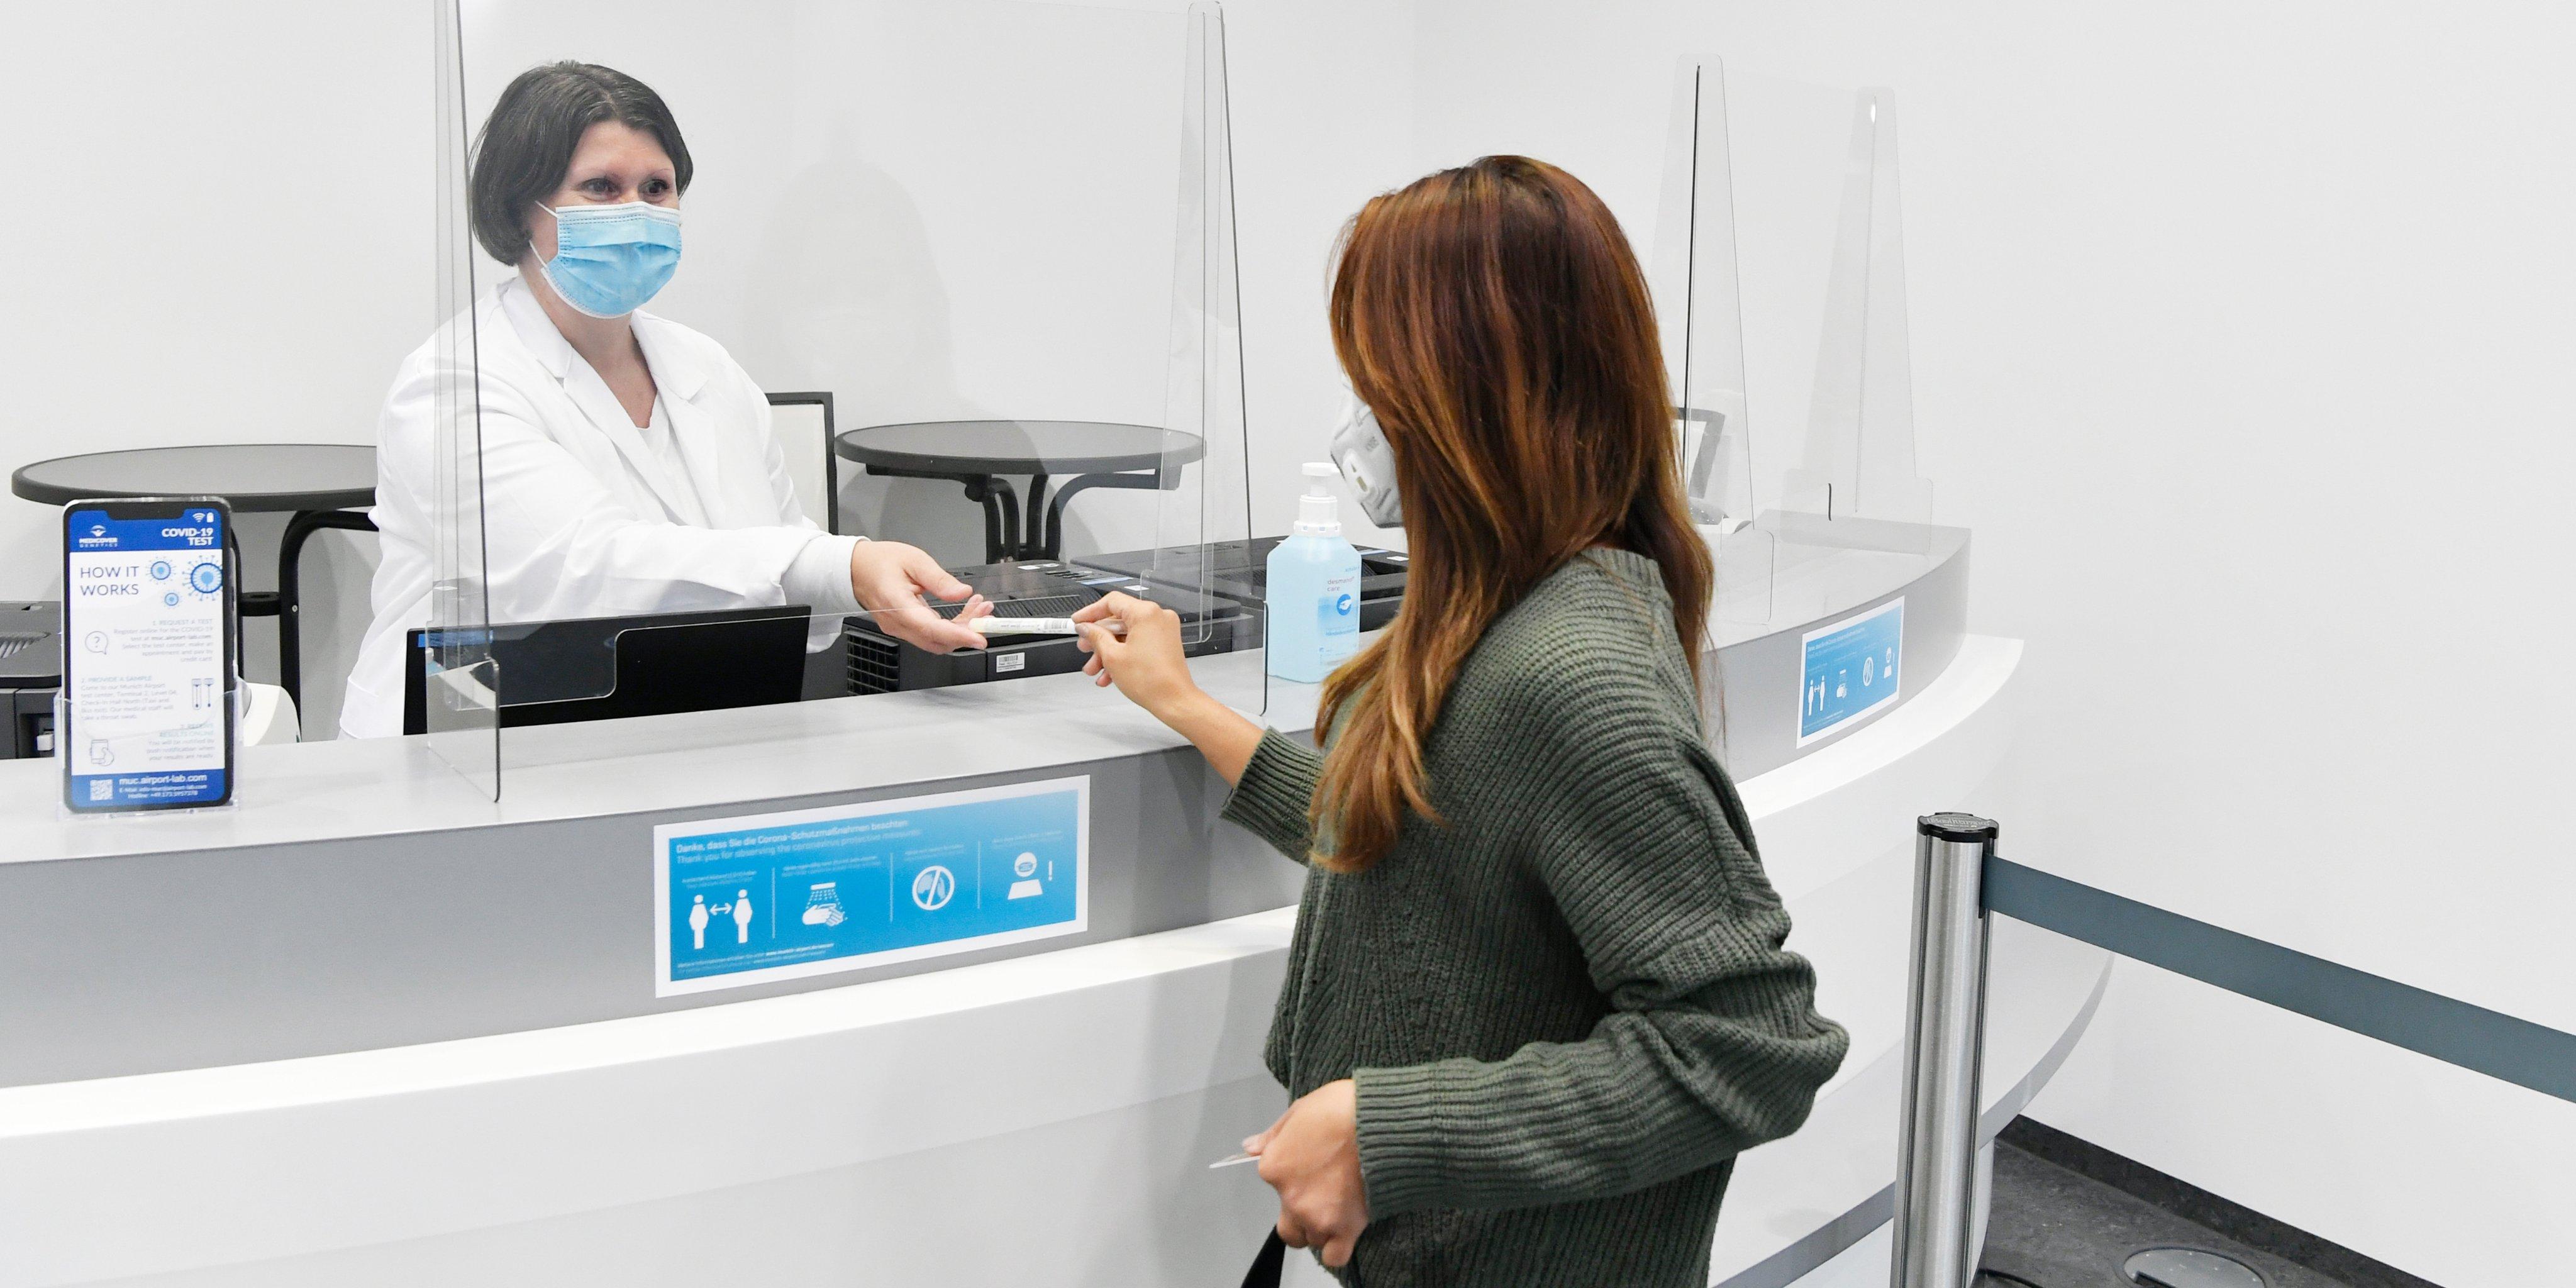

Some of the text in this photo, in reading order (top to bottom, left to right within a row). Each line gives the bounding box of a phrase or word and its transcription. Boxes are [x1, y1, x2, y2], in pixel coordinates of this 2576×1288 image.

[162, 528, 214, 538] COVID-19
[187, 537, 214, 546] TEST
[80, 566, 140, 579] HOW IT
[80, 584, 139, 596] WORKS
[119, 774, 207, 785] muc.airport-lab.com
[707, 840, 727, 850] dass
[728, 838, 742, 847] Sie
